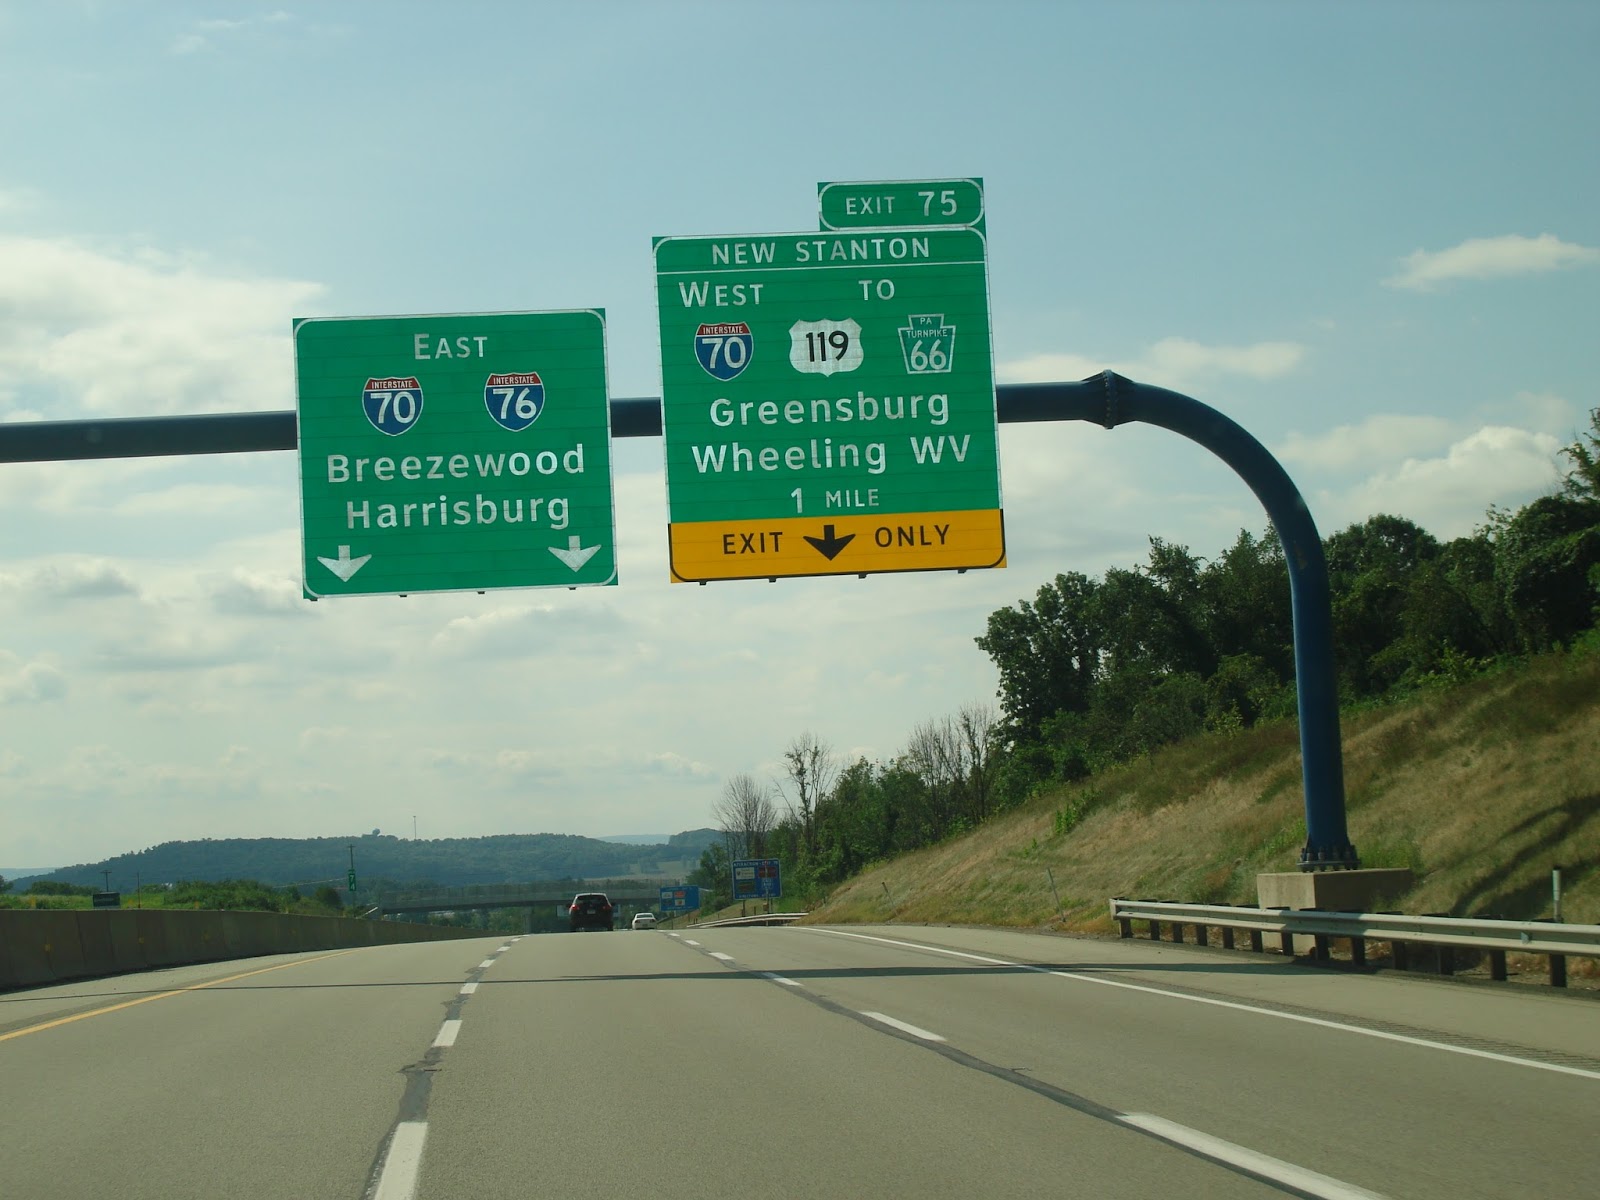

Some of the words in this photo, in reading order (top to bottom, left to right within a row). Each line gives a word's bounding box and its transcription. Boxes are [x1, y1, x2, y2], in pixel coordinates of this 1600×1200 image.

[845, 196, 896, 215] EXIT
[918, 190, 958, 217] 75
[712, 242, 776, 265] NEW
[796, 237, 930, 263] STANTON
[679, 281, 764, 308] WEST
[858, 278, 895, 301] TO
[702, 325, 744, 335] INTERSTATE
[906, 328, 948, 339] TURNPIKE
[919, 317, 933, 326] PA
[414, 333, 488, 360] EAST
[701, 336, 746, 370] 70
[805, 330, 849, 363] 119
[910, 339, 947, 372] 66
[371, 379, 413, 390] INTERSTATE
[492, 375, 535, 386] INTERSTATE
[370, 391, 416, 424] 70
[492, 387, 537, 420] 76
[709, 391, 950, 427] Greensburg
[327, 443, 584, 483] Breezewood
[691, 438, 887, 475] Wheeling
[910, 434, 971, 465] WV
[346, 494, 569, 530] Harrisburg
[790, 487, 803, 514] 1
[825, 488, 880, 509] MILE
[722, 531, 784, 555] EXIT
[874, 524, 951, 548] ONLY
